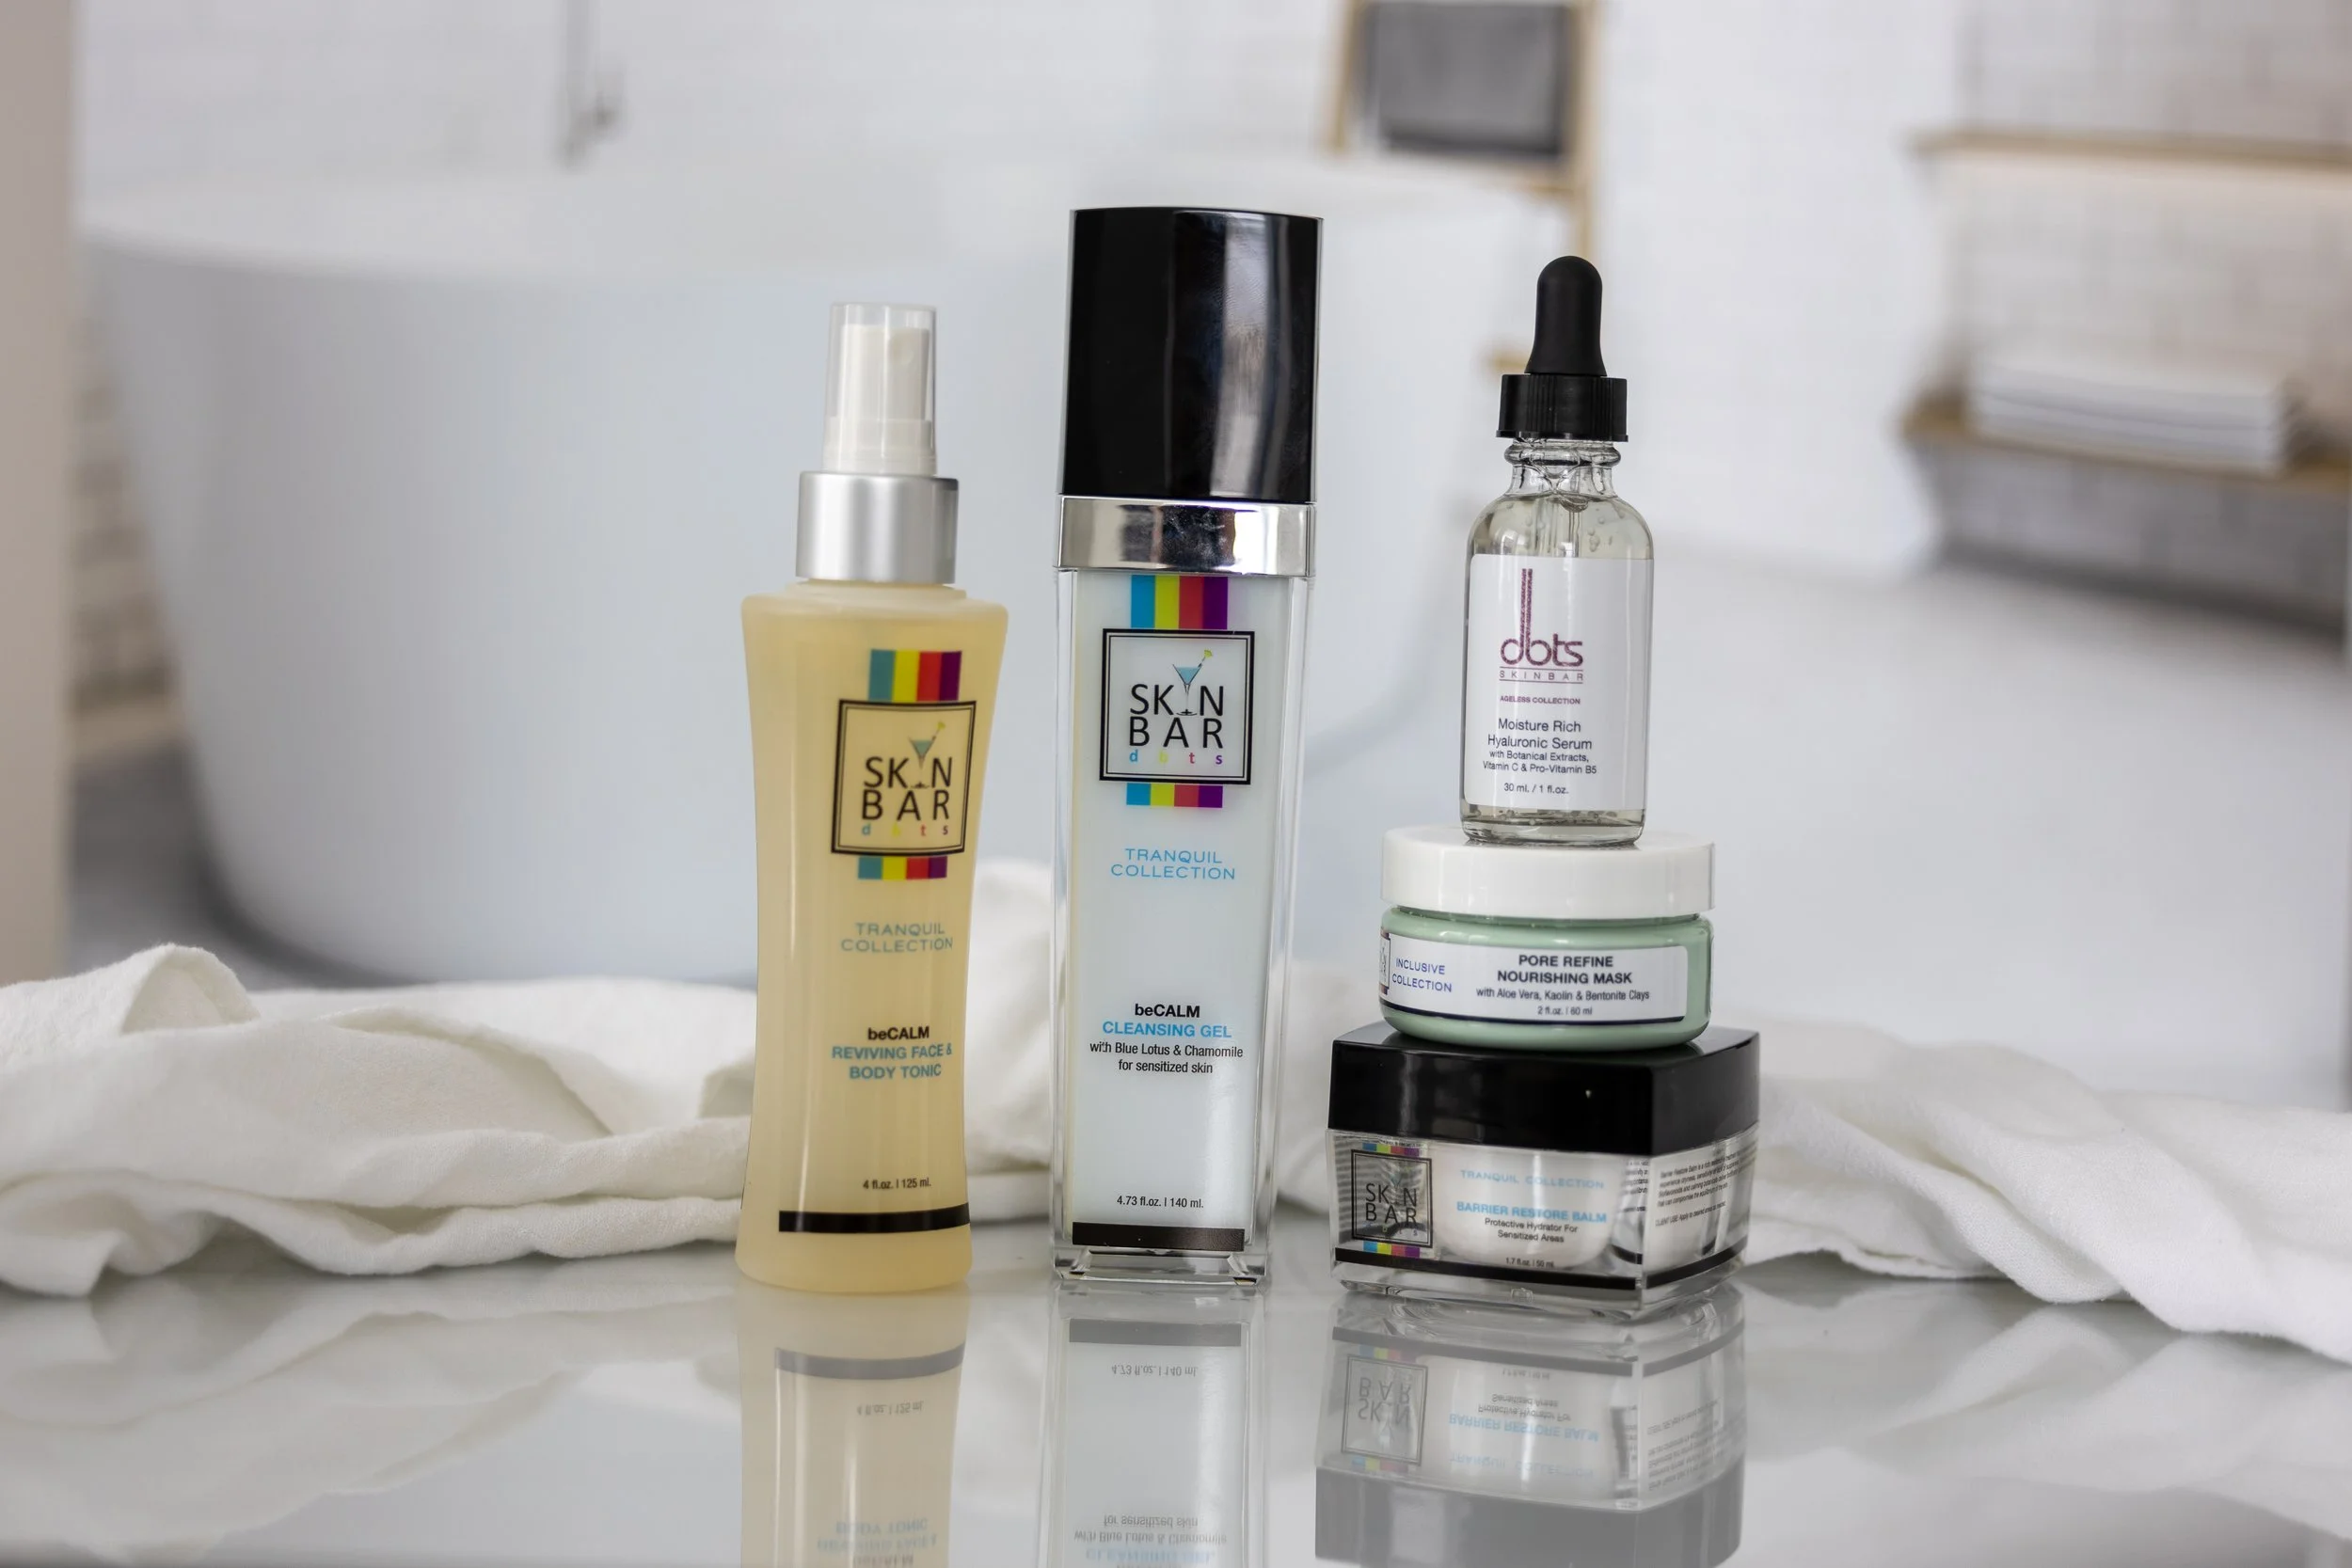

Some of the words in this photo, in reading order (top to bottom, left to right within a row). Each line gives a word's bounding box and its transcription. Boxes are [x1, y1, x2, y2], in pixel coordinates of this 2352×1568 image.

[1500, 695, 1531, 704] AGELESS
[1532, 696, 1581, 705] COLLECTION
[1129, 717, 1223, 749] BAR
[1498, 719, 1549, 732] Moisture
[1553, 721, 1581, 733] Rich
[1487, 735, 1548, 749] Hyaluronic
[1552, 737, 1593, 751] Serum
[1489, 751, 1504, 759] with
[1507, 751, 1548, 761] Botanical
[1550, 752, 1589, 763] Extracts,
[1483, 761, 1509, 771] Vitamin
[1512, 763, 1519, 771] C
[1520, 764, 1528, 772] &
[1530, 763, 1582, 774] Pro-Vitamin
[1585, 765, 1597, 774] B5
[1503, 784, 1515, 792] 30
[862, 790, 949, 821] BAR
[1125, 848, 1222, 864] TRANQUIL
[1111, 863, 1235, 880] COLLECTION
[856, 922, 946, 938] TRANQUIL
[840, 937, 953, 954] COLLECTION
[1396, 958, 1445, 975] INCLUSIVE
[1518, 955, 1558, 967] PORE
[1564, 955, 1613, 968] REFINE
[1392, 973, 1453, 993] COLLECTION
[1497, 970, 1588, 984] NOURISHING
[1594, 971, 1632, 984] MASK
[1476, 987, 1495, 998] with
[1497, 988, 1518, 999] Aloe
[1518, 989, 1542, 1001] Vera,
[1544, 990, 1573, 1001] Kaolin
[1576, 990, 1583, 1001] &
[1585, 990, 1626, 1001] Bentonite
[1629, 989, 1650, 1002] Clays
[1135, 1003, 1200, 1019] beCALM
[1537, 1006, 1543, 1015] 2
[867, 1026, 930, 1041] beCALM
[1102, 1021, 1196, 1037] CLEANSING
[1200, 1024, 1232, 1038] GEL
[832, 1045, 907, 1060] REVIVING
[911, 1043, 944, 1059] FACE
[946, 1043, 953, 1055] &
[1089, 1041, 1112, 1053] with
[1115, 1042, 1138, 1054] Blue
[1141, 1043, 1170, 1056] Lotus
[1172, 1044, 1182, 1056] &
[1184, 1045, 1244, 1058] Chamomile
[850, 1065, 896, 1080] BODY
[900, 1063, 942, 1079] TONIC
[1118, 1059, 1134, 1071] for
[1136, 1059, 1189, 1073] sensitized
[1191, 1061, 1214, 1074] skin
[863, 1180, 869, 1190] 4
[901, 1178, 918, 1189] 125
[1461, 1169, 1519, 1184] TRANQUIL
[1525, 1175, 1604, 1189] COLLECTION
[1117, 1196, 1137, 1206] 4.73
[1169, 1197, 1187, 1208] 140
[1189, 1197, 1204, 1209] ml.
[1365, 1202, 1418, 1226] BAR
[1456, 1201, 1508, 1216] BARRIER
[1512, 1206, 1568, 1220] RESTORE
[1572, 1212, 1607, 1223] BALM
[1485, 1217, 1525, 1229] Protective
[1527, 1222, 1562, 1232] Hydrator
[1565, 1224, 1578, 1232] For
[1498, 1230, 1538, 1241] Sensitized
[1541, 1234, 1565, 1243] Areas
